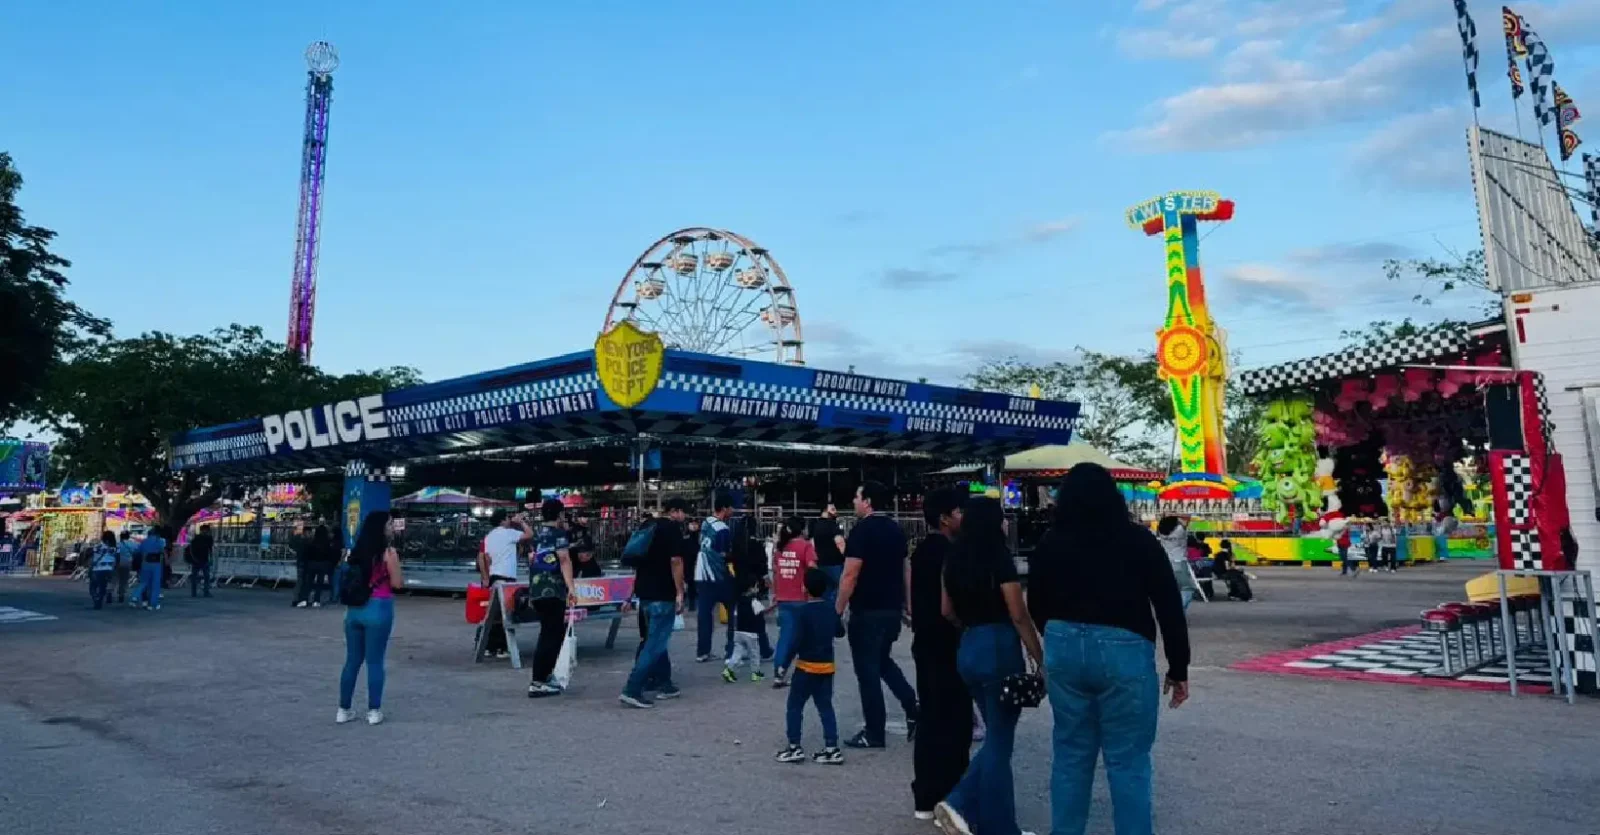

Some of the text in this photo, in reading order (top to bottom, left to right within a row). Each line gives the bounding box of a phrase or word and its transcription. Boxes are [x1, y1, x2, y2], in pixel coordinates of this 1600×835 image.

[1129, 196, 1215, 225] TWISTER
[602, 339, 658, 358] NEW YORK
[605, 357, 648, 378] POLICE
[612, 377, 645, 396] DEPT
[814, 372, 907, 397] BROOKLYN NORTH
[414, 418, 440, 434] YORK
[444, 413, 467, 430] CITY
[474, 405, 512, 427] POLICE
[518, 392, 595, 420] DEPARTMENT
[701, 395, 820, 421] MANHATTAN SOUTH
[262, 393, 390, 455] POLICE
[906, 417, 974, 435] QUEENS SOUTH
